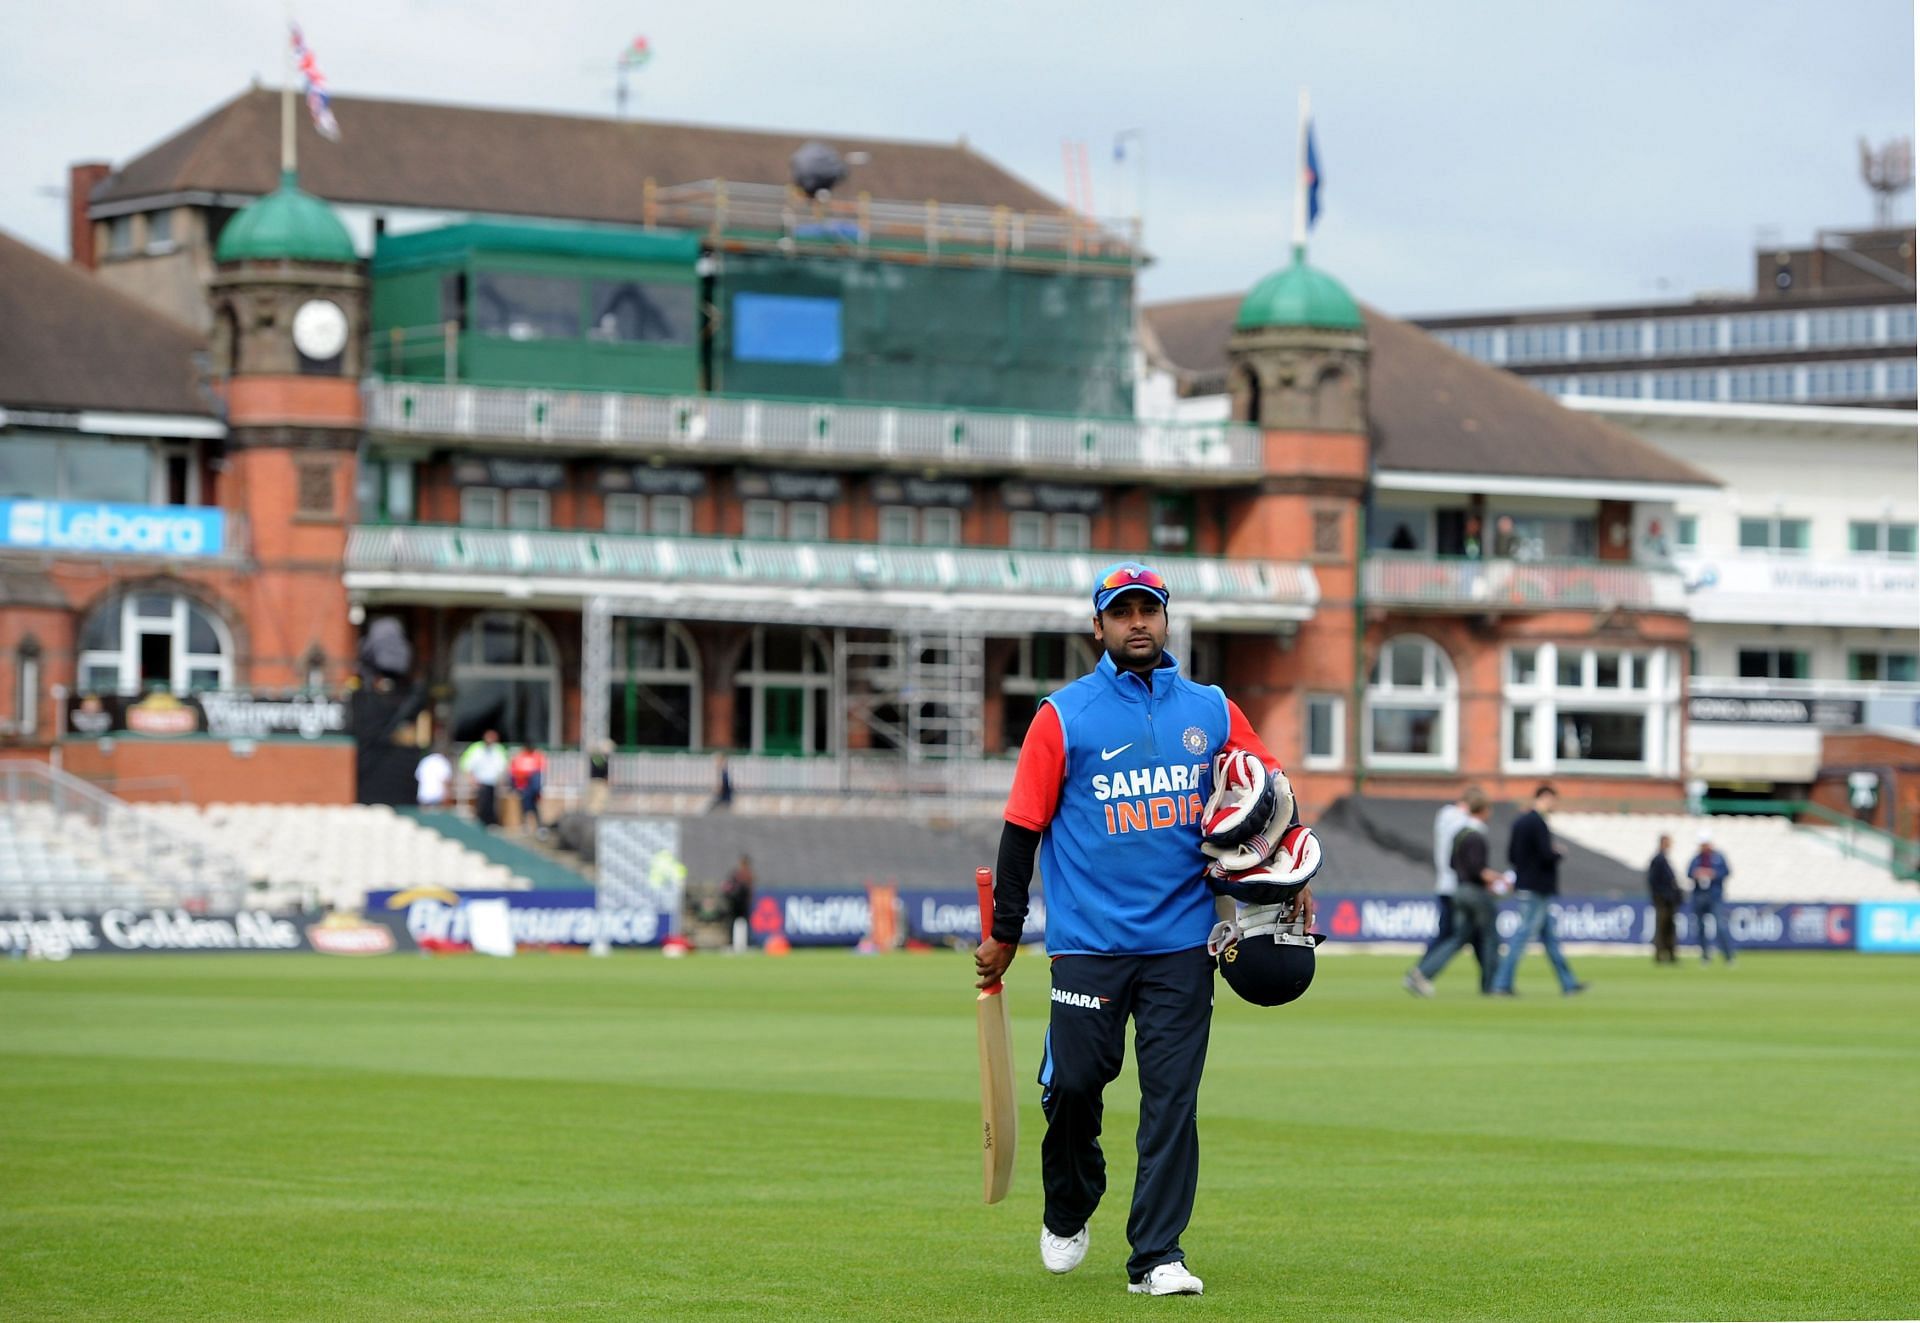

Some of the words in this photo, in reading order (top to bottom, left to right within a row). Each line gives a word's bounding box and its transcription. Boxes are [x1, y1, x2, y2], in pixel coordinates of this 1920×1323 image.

[51, 502, 203, 553] Lebara
[1091, 764, 1199, 801] SAHARA
[101, 909, 238, 949] Golden
[235, 910, 300, 949] Ale
[1728, 907, 1783, 942] Club
[1050, 987, 1101, 1010] SAHARA
